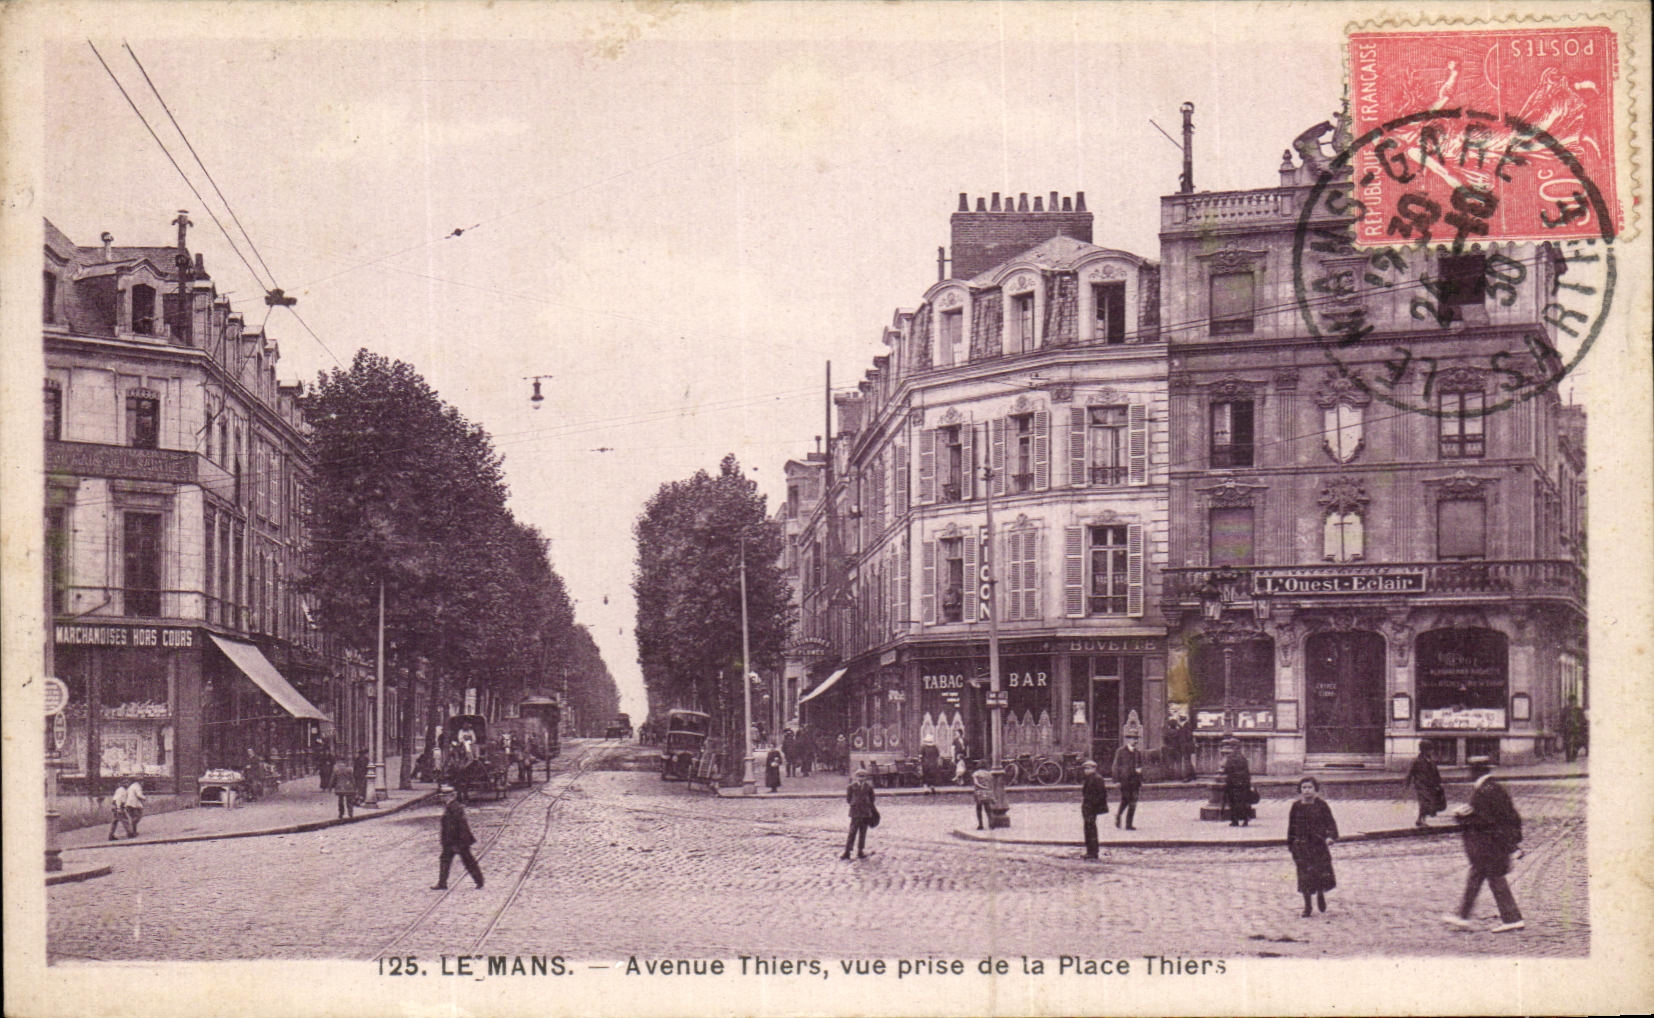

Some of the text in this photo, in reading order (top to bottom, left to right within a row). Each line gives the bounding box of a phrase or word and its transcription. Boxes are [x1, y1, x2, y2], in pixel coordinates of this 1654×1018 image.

[1511, 39, 1594, 57] POSTES
[1360, 43, 1378, 122] FRANÇAISE
[55, 626, 193, 647] MARCHANDISES HORS COURS
[1070, 639, 1157, 651] BUVETTE
[923, 674, 964, 690] TABAC
[1009, 672, 1047, 688] BAR
